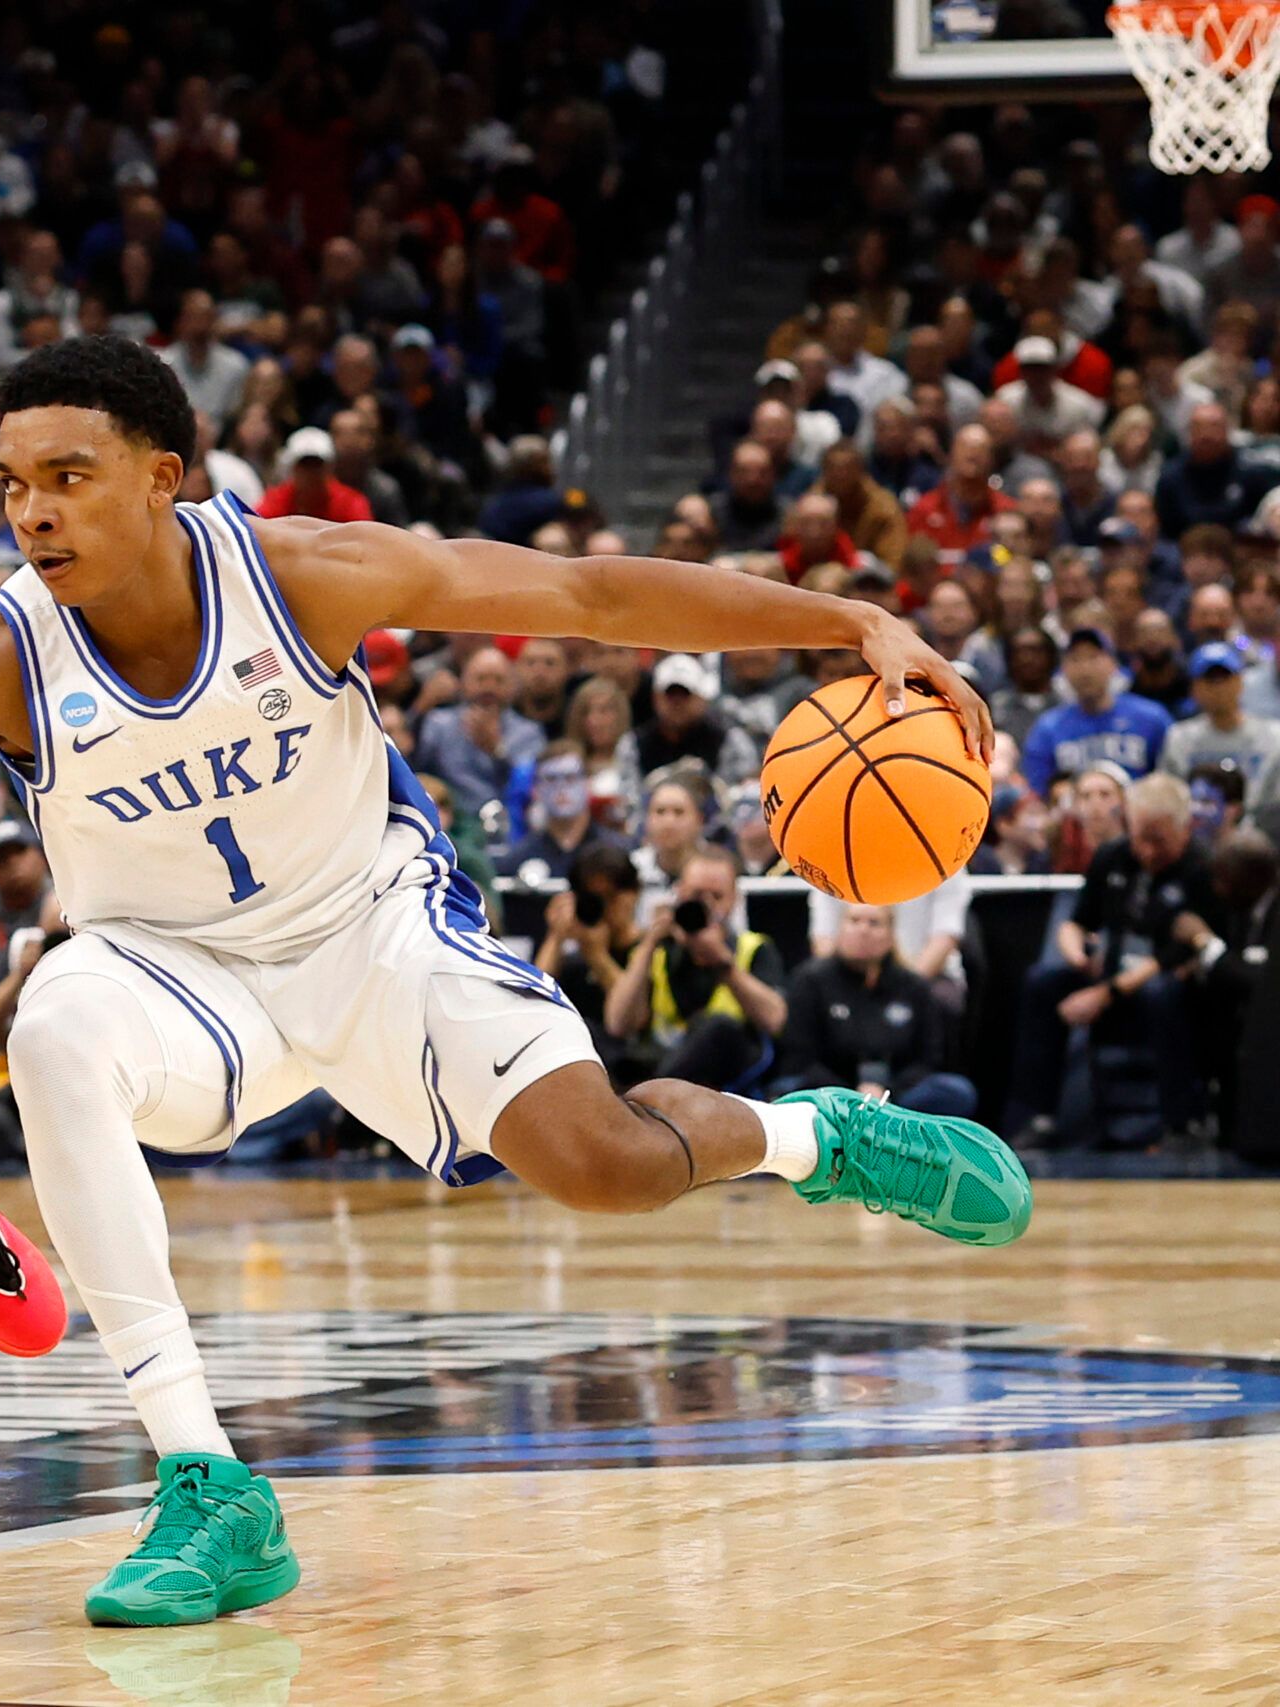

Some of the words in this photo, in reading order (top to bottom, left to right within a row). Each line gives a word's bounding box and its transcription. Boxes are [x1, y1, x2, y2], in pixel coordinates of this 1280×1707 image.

[65, 704, 96, 720] NCAA
[263, 693, 289, 714] ACC
[85, 723, 312, 823] DUKE
[203, 816, 266, 904] 1
